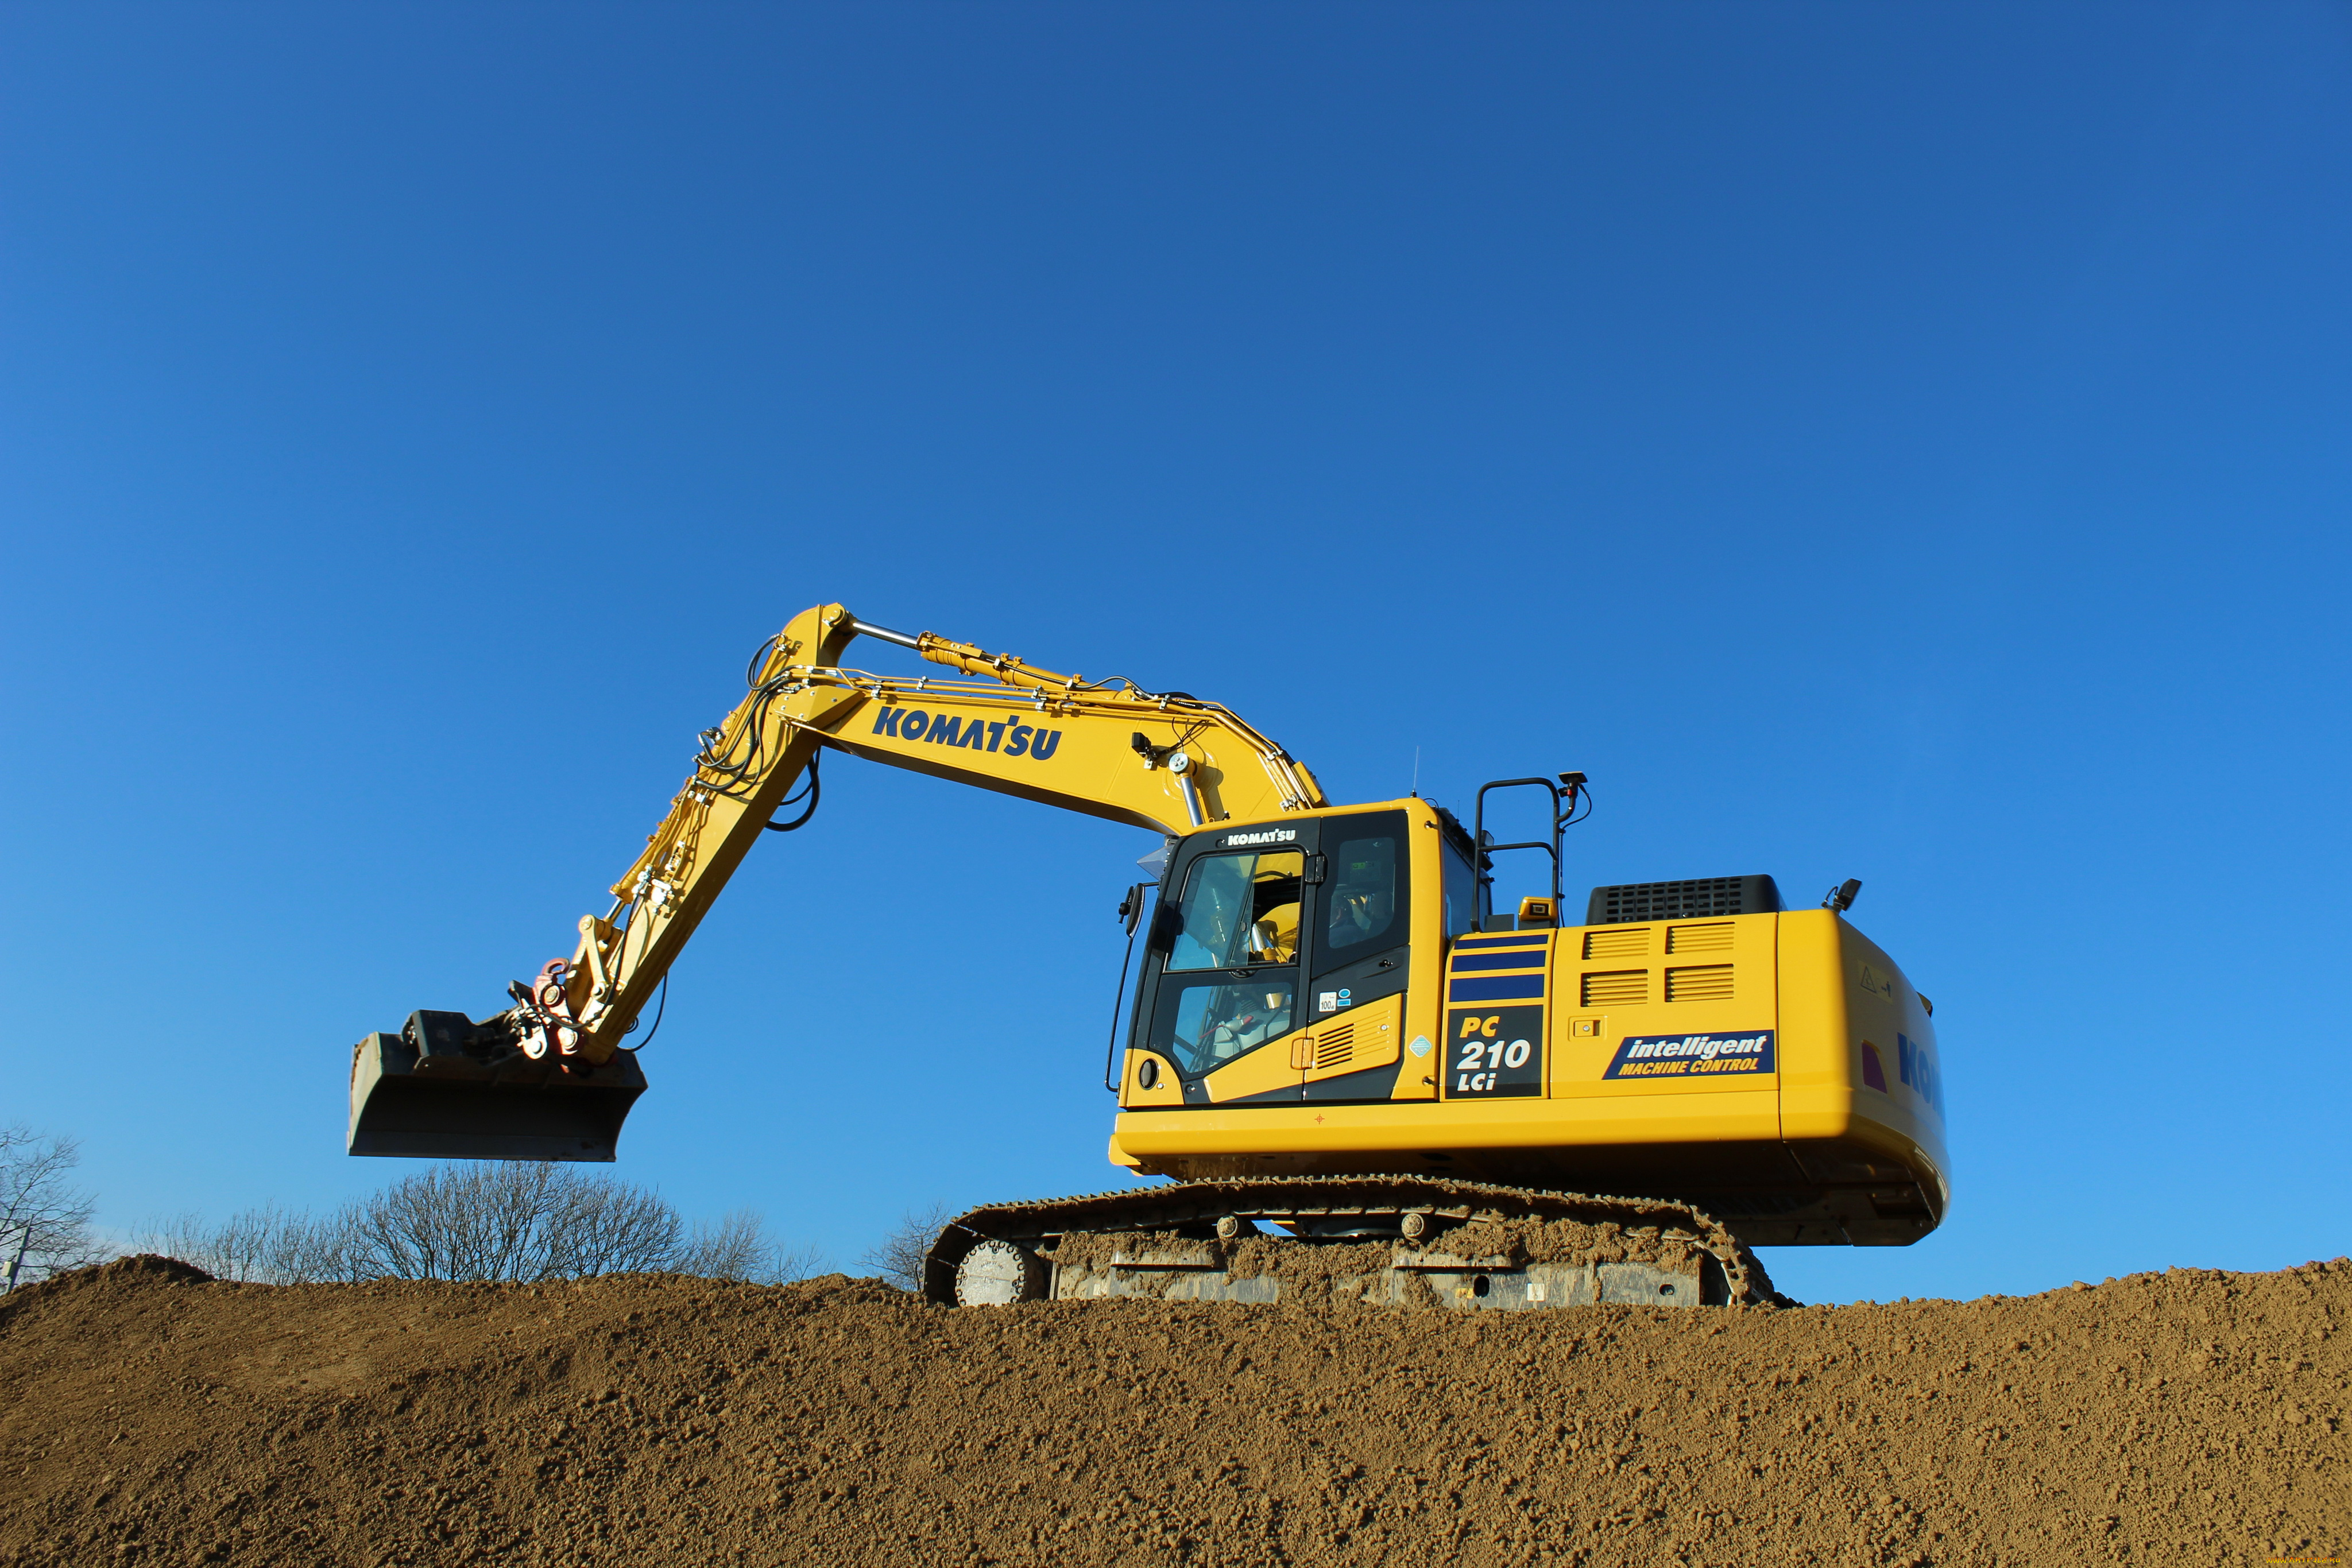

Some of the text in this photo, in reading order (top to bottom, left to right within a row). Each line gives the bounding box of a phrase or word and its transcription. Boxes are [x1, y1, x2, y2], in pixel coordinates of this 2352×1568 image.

[872, 706, 1062, 760] KOMATSU
[1228, 828, 1295, 846] KOMATSU
[1321, 1001, 1331, 1009] 100
[1459, 1016, 1500, 1038] PC
[1456, 1039, 1531, 1070] 210
[1627, 1035, 1767, 1060] intelligent
[1618, 1058, 1758, 1075] MACHINE CONTROL
[1457, 1073, 1496, 1091] LCi
